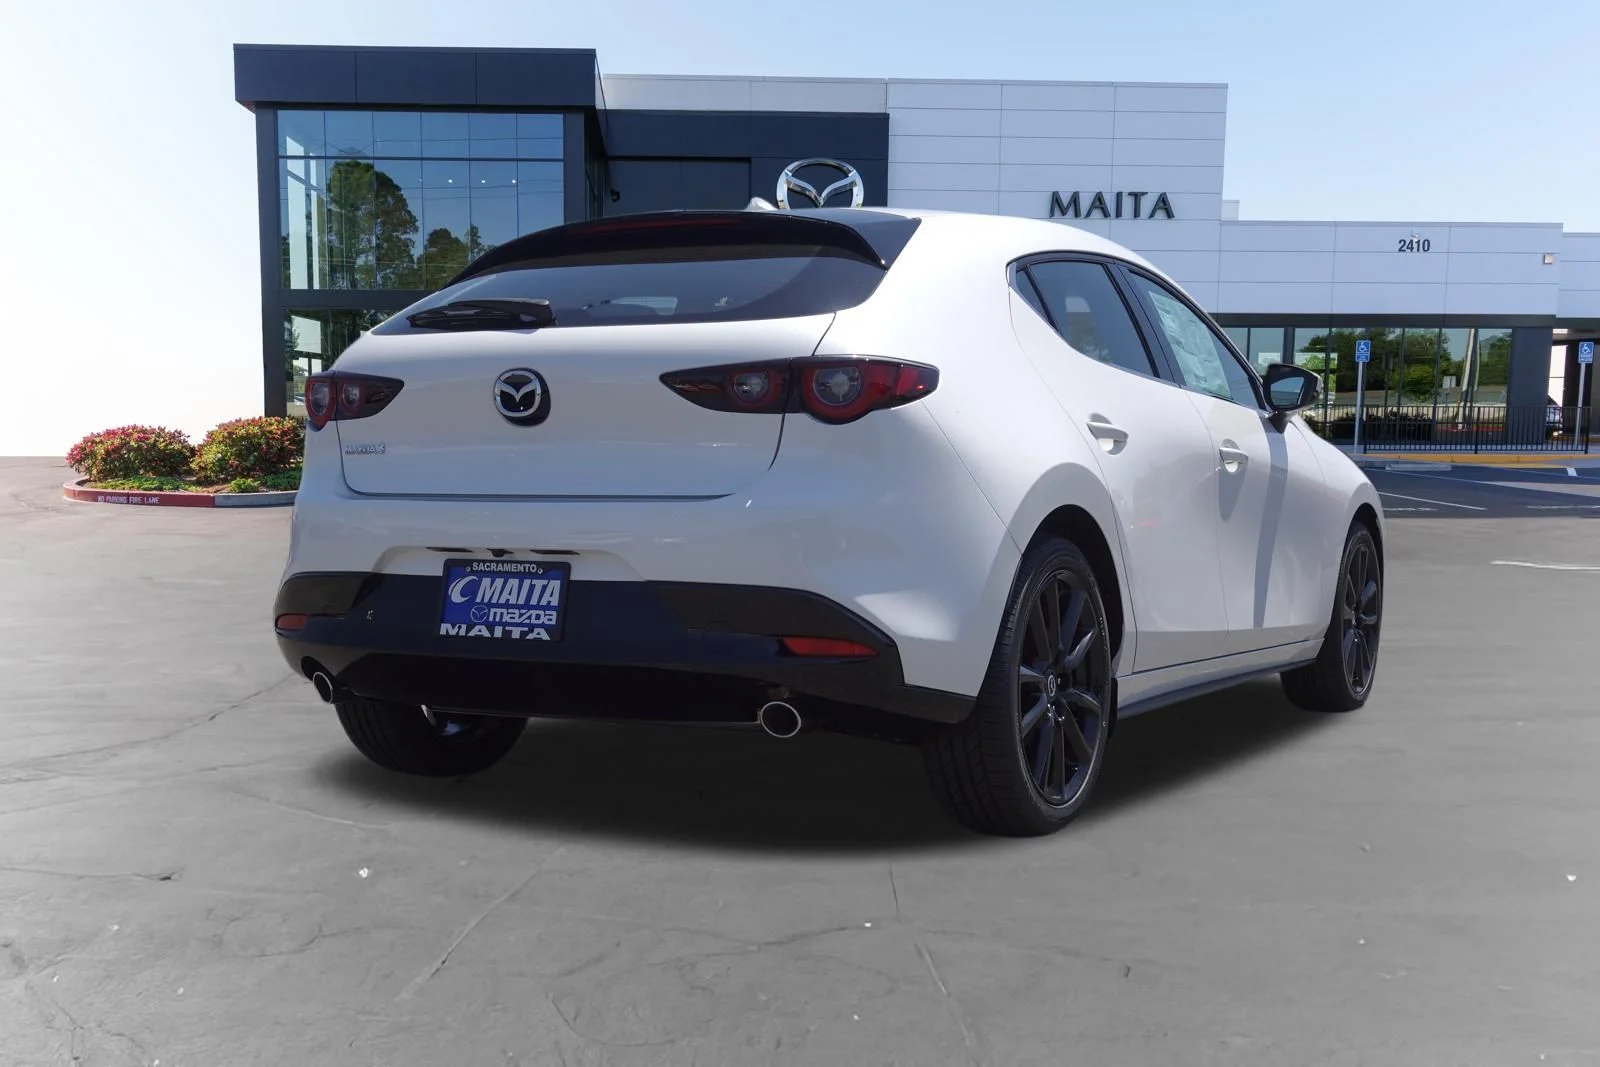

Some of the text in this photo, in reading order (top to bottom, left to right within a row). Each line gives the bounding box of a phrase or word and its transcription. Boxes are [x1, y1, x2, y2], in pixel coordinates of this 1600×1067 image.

[1049, 190, 1175, 218] MAITA
[1398, 238, 1431, 252] 2410
[129, 496, 143, 504] FIRE
[144, 496, 160, 504] LANE
[472, 562, 537, 573] SACRAMENTO
[475, 577, 561, 606] MAITA
[439, 623, 552, 641] MAITA
